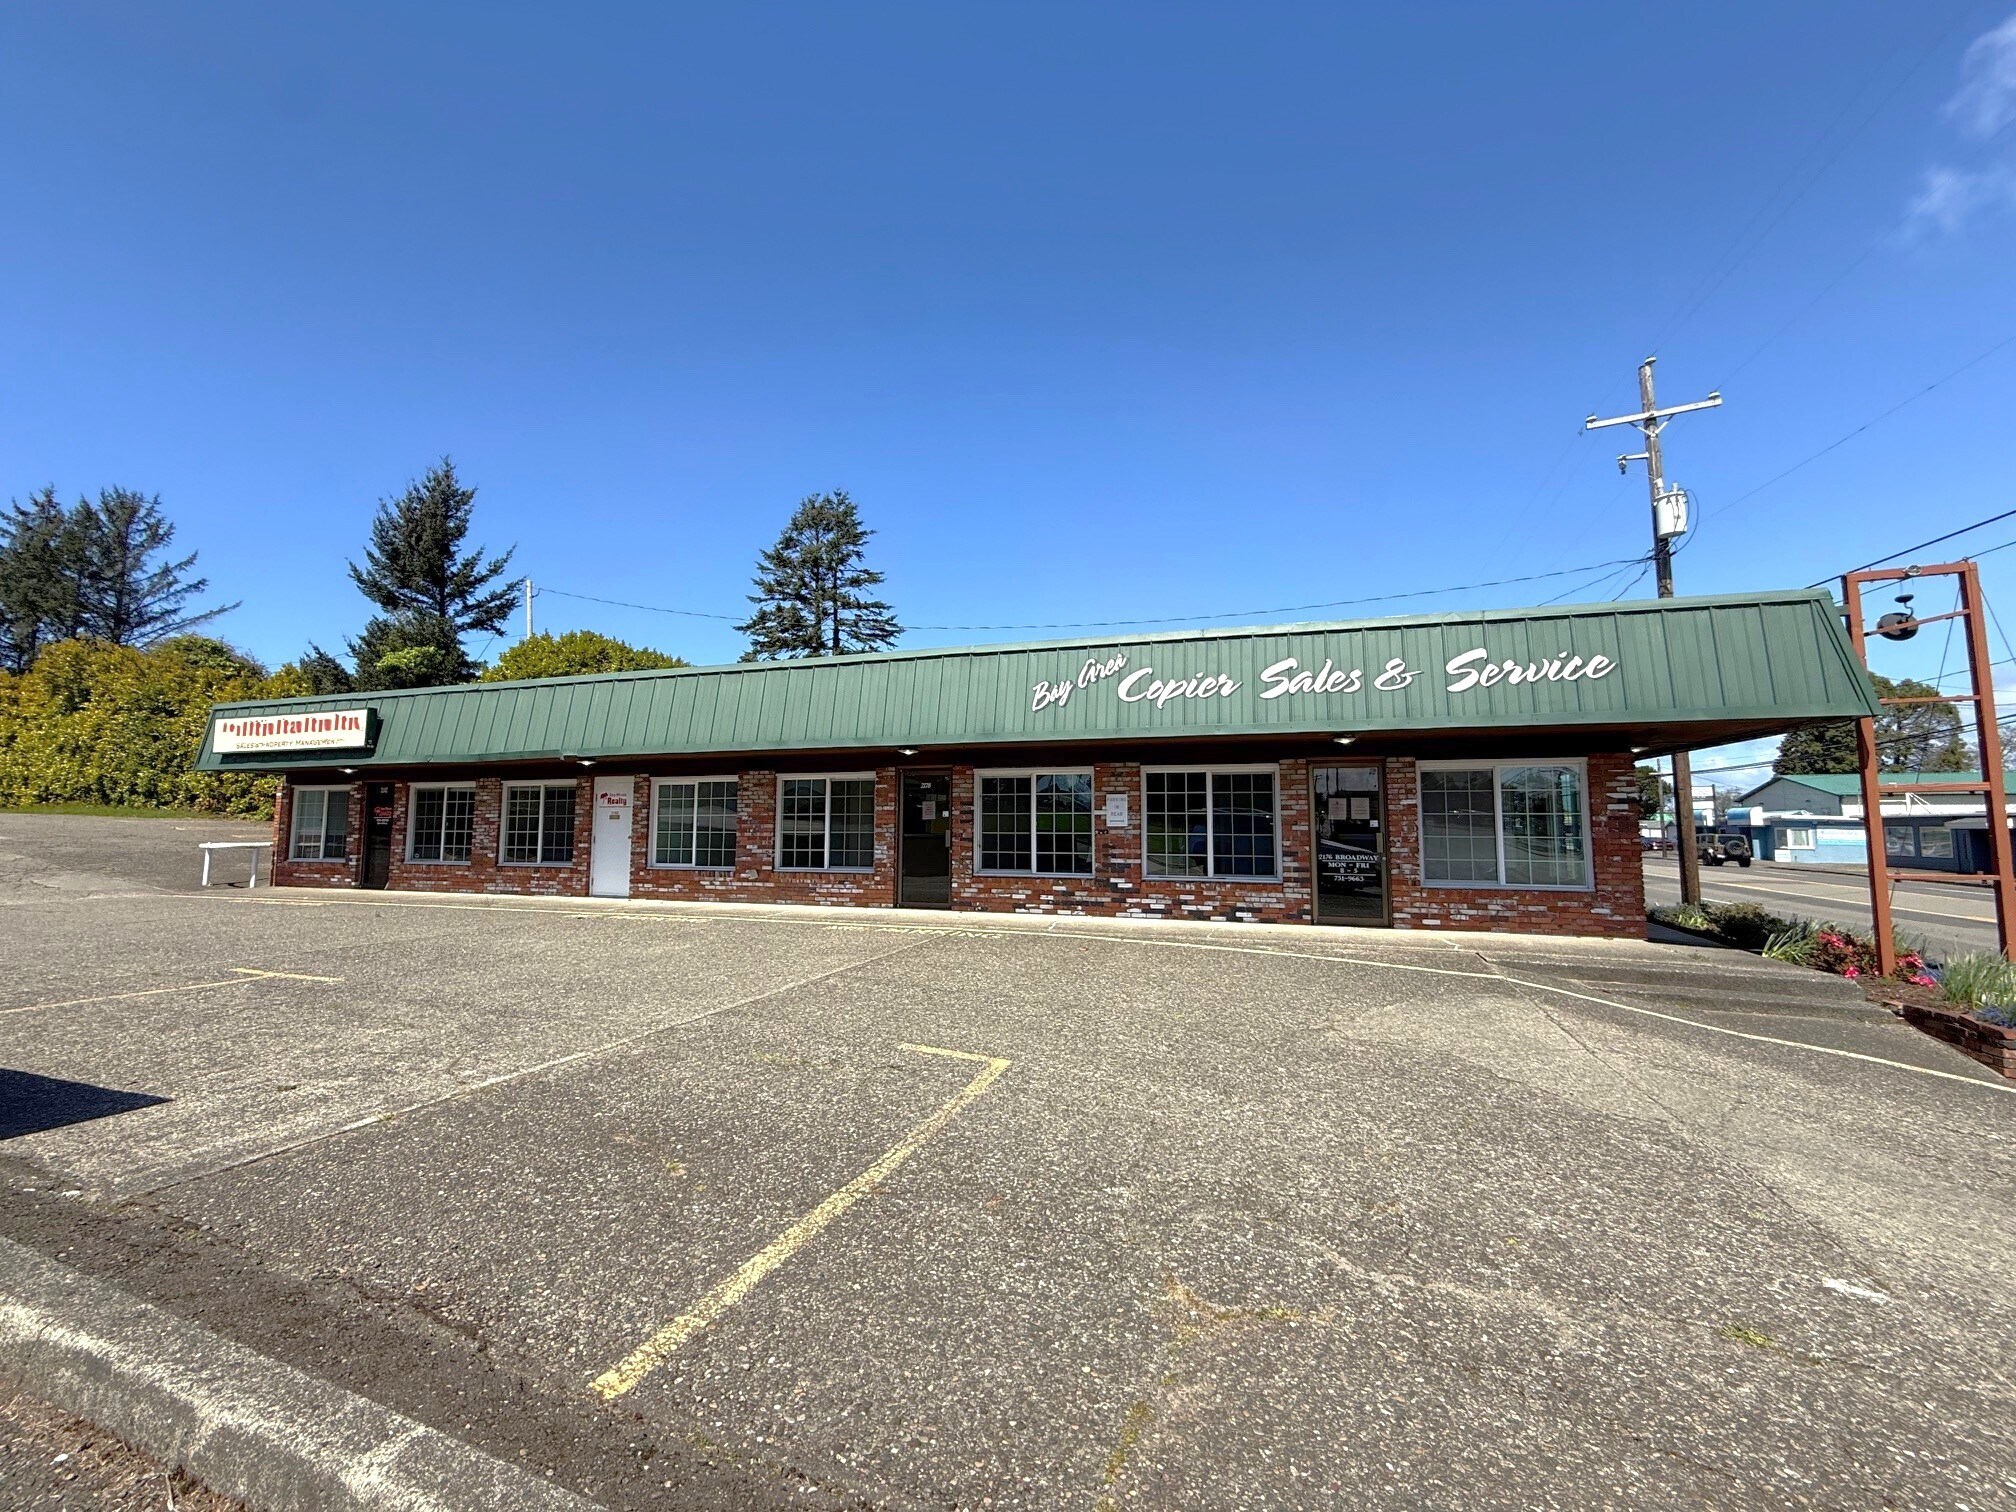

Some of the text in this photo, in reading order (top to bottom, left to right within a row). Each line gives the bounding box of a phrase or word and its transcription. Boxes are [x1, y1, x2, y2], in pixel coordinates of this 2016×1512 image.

[1031, 653, 1128, 712] Bay Area
[1117, 647, 1618, 709] Copier Sales & Service
[607, 797, 627, 805] Realty
